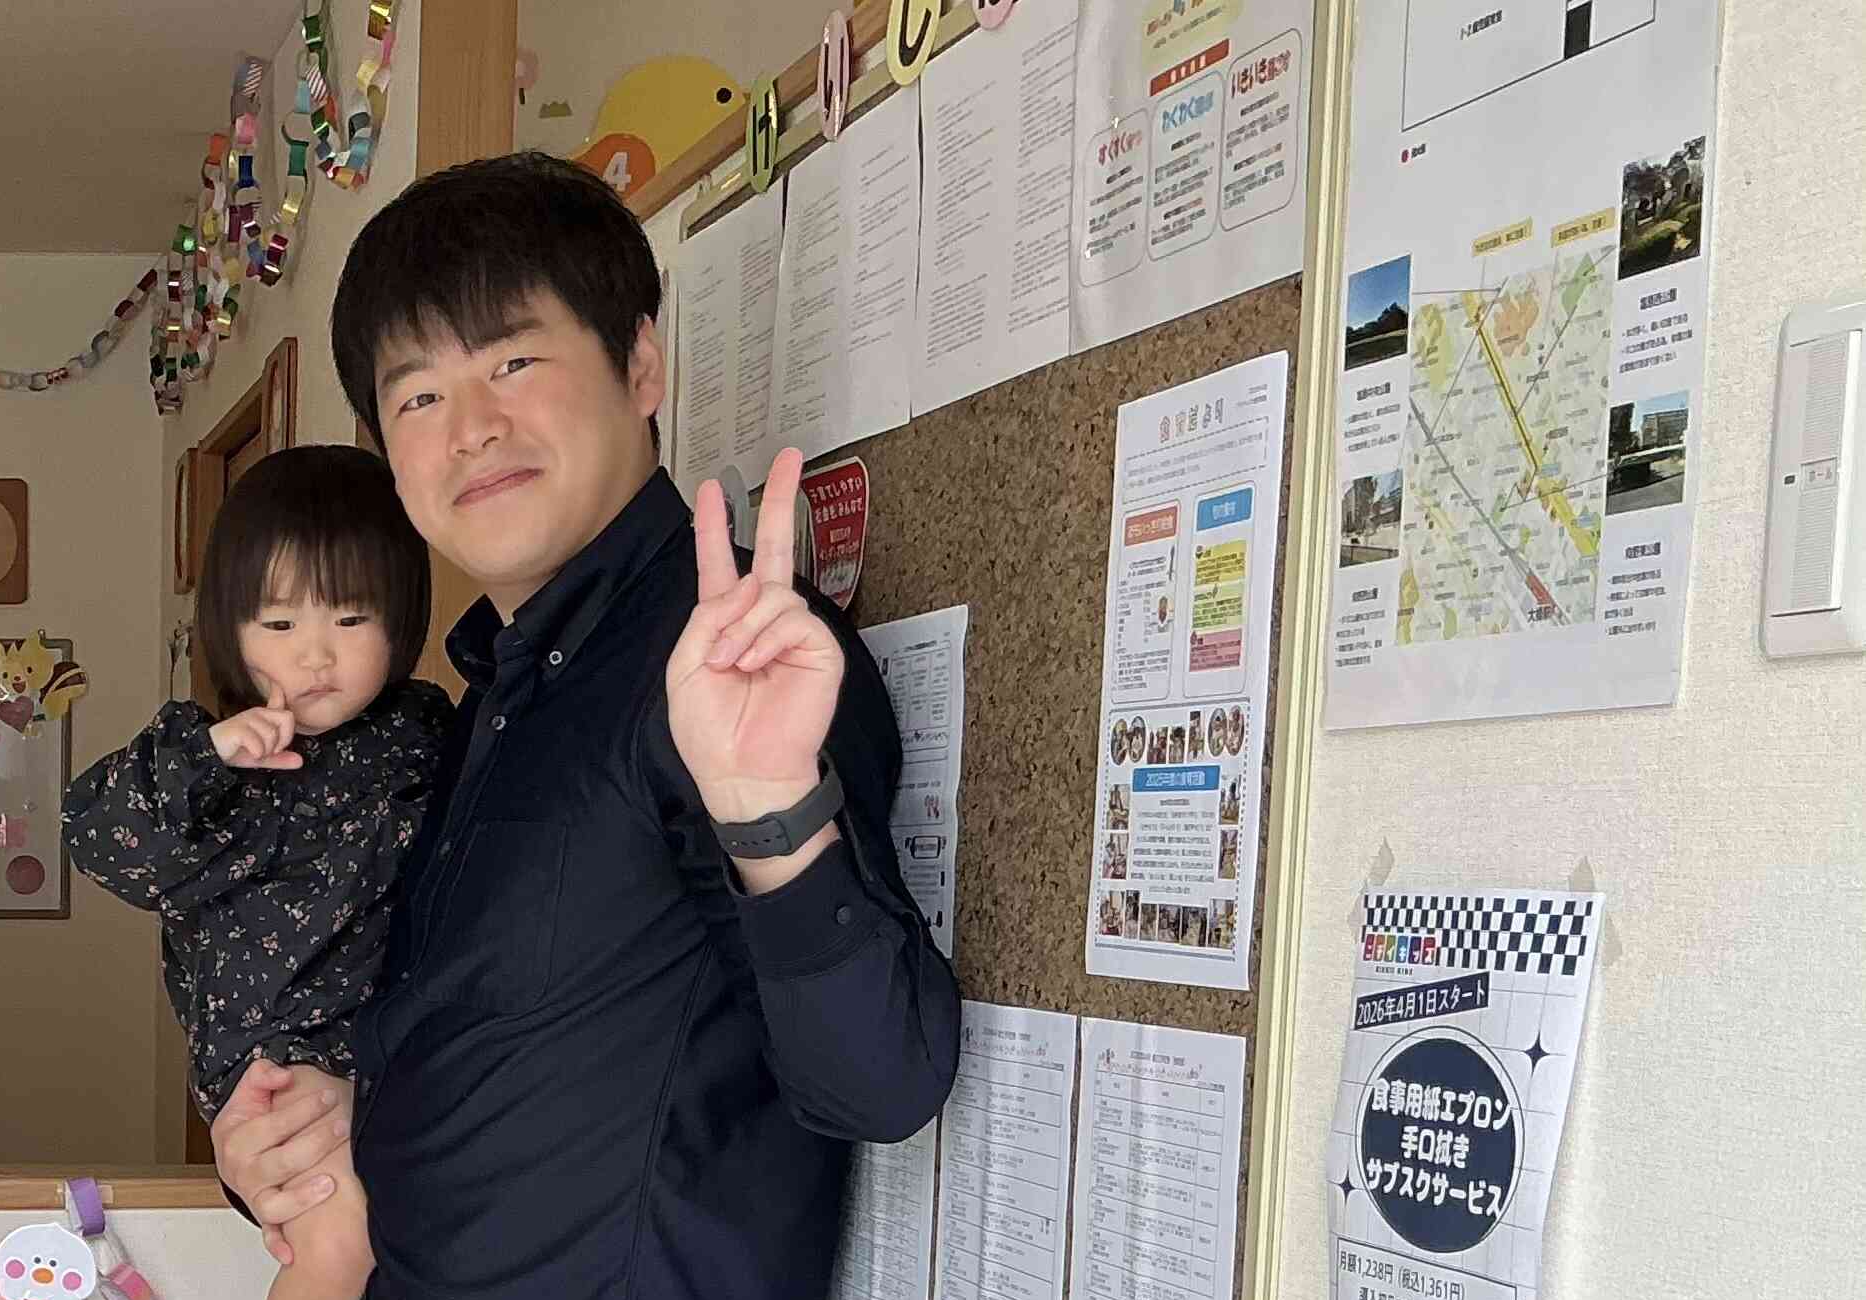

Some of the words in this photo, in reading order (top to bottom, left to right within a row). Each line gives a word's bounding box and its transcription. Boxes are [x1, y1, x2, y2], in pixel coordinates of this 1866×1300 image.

[603, 151, 631, 192] 4
[1356, 979, 1487, 1027] 2026年4月1日スタート
[1371, 1077, 1511, 1131] 食事用紙エプロン
[1400, 1125, 1470, 1169] 手口拭き
[1366, 1157, 1504, 1218] サブスクサービス
